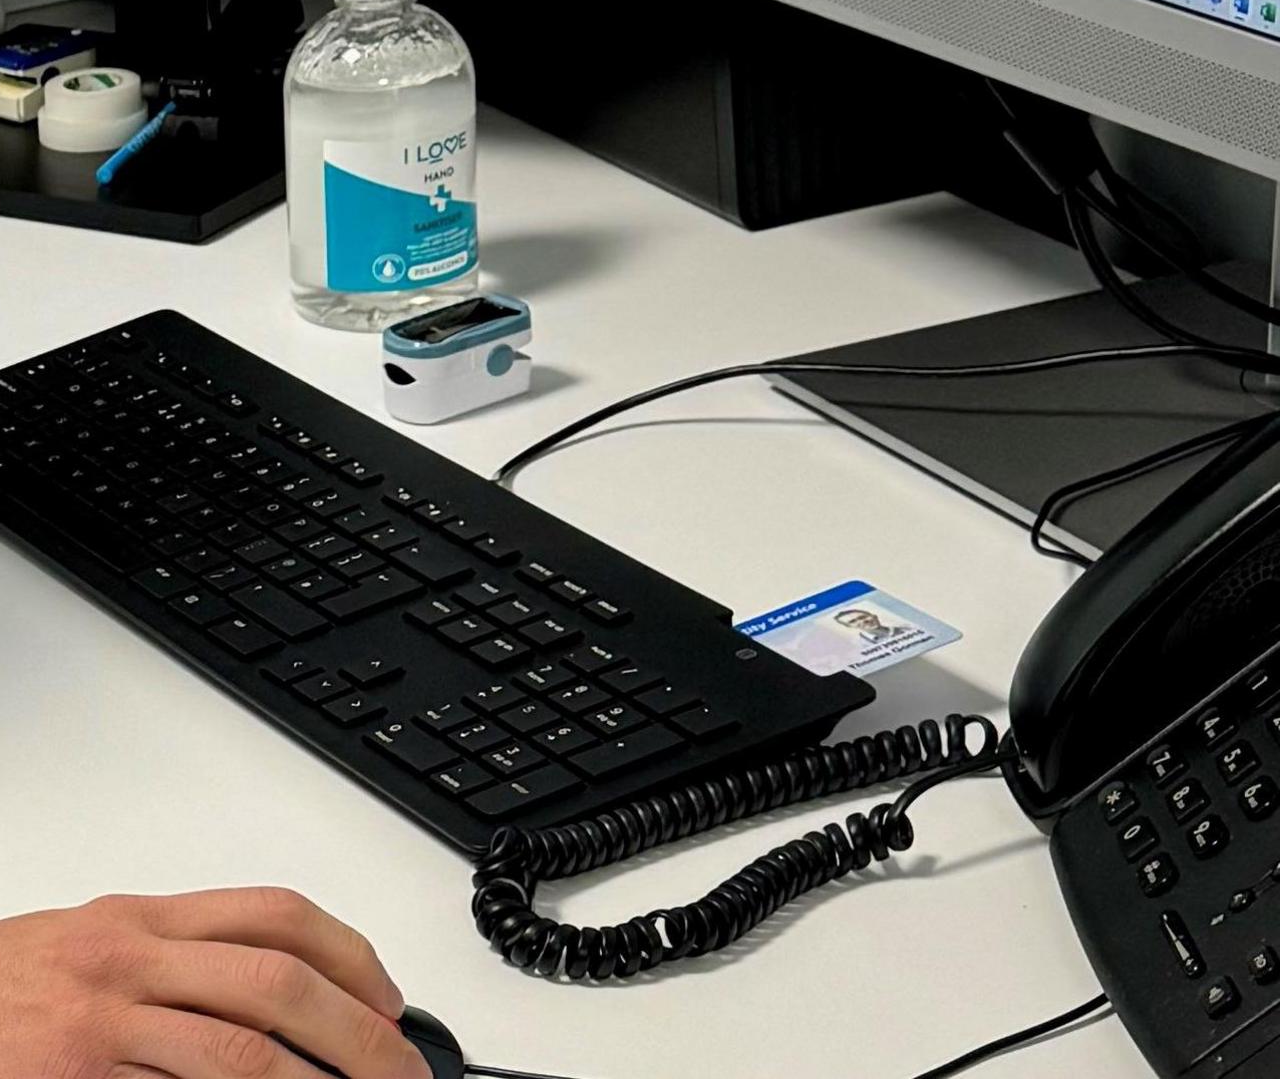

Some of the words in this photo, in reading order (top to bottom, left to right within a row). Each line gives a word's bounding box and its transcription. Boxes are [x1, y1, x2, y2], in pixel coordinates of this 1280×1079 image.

[403, 147, 409, 165] I
[424, 166, 455, 184] HAND
[768, 601, 818, 626] Service
[1152, 751, 1171, 766] 7
[1223, 747, 1241, 763] 5
[1172, 785, 1190, 801] 8
[1123, 824, 1141, 840] 0
